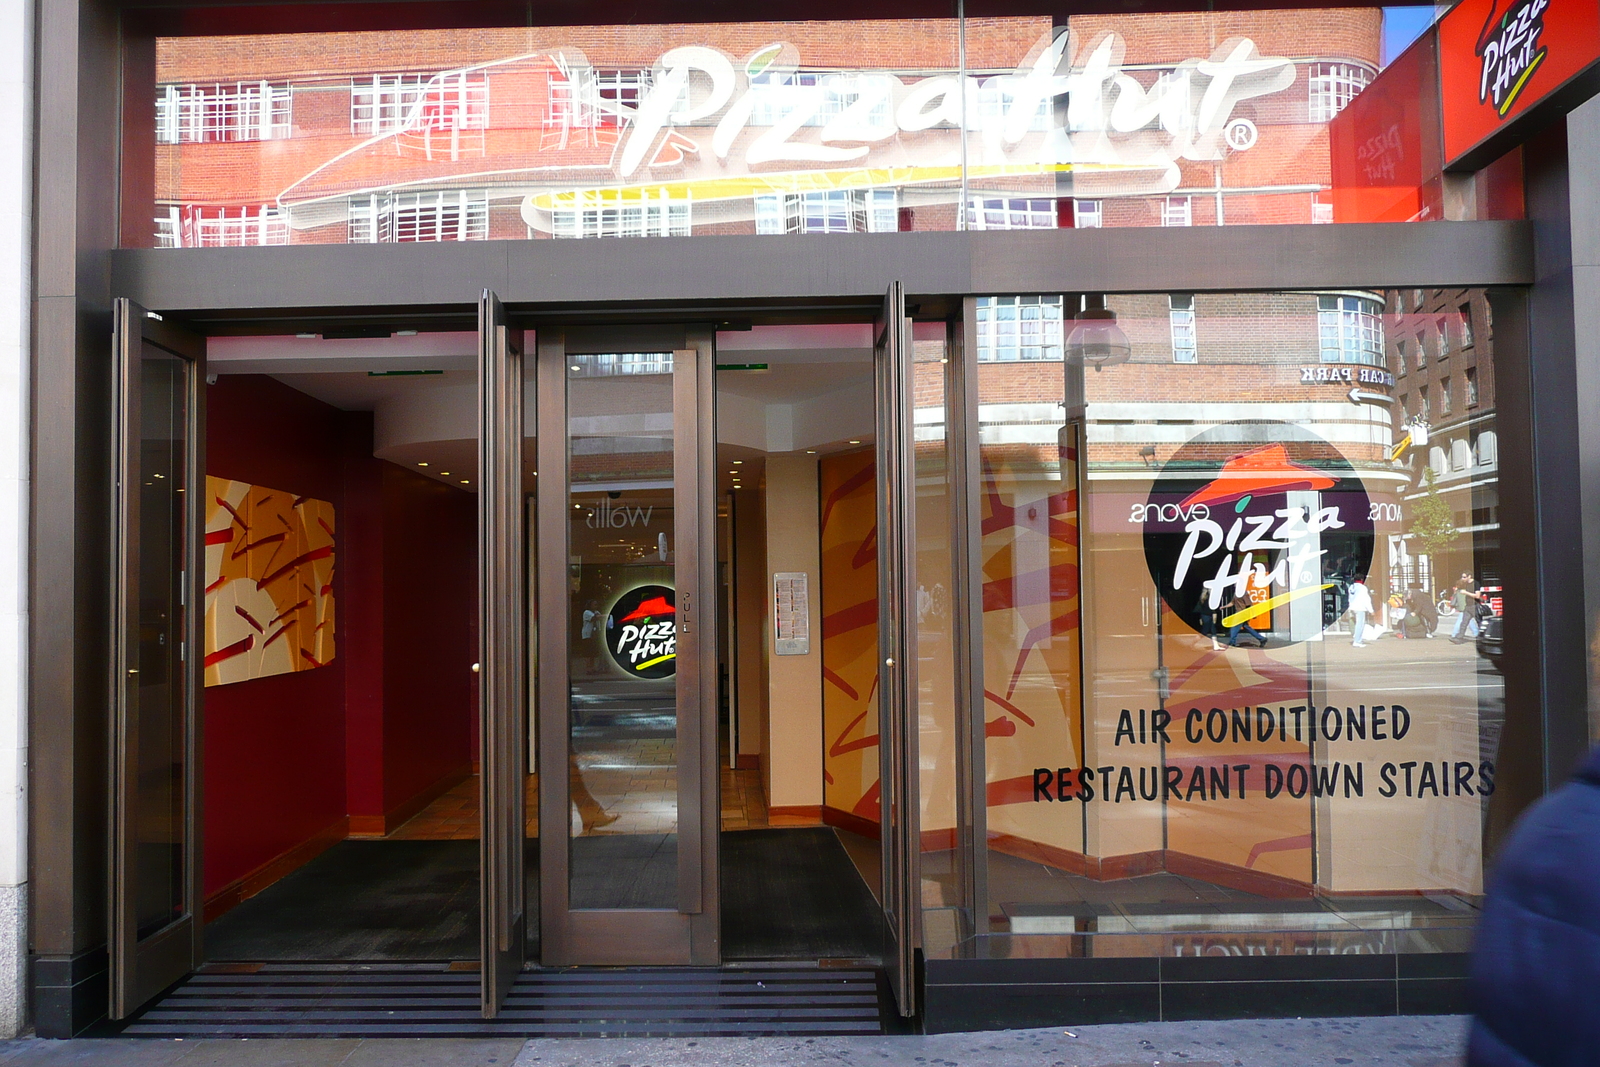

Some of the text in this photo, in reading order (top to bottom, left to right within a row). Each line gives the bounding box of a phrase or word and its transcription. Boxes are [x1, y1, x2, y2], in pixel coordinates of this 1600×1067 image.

[1481, 0, 1547, 100] Pizza
[1492, 27, 1540, 104] Hut
[620, 44, 972, 177] Pizza
[1002, 31, 1291, 143] Hut
[1173, 495, 1346, 590] Pizza
[1203, 543, 1328, 610] Hut
[617, 616, 676, 655] Pizz
[683, 592, 691, 634] PULL
[629, 636, 676, 663] Hut
[1114, 708, 1172, 747] AIR
[1185, 704, 1411, 744] CONDITIONED
[1032, 760, 1496, 803] RESTAURANT DOWN STAIRS
